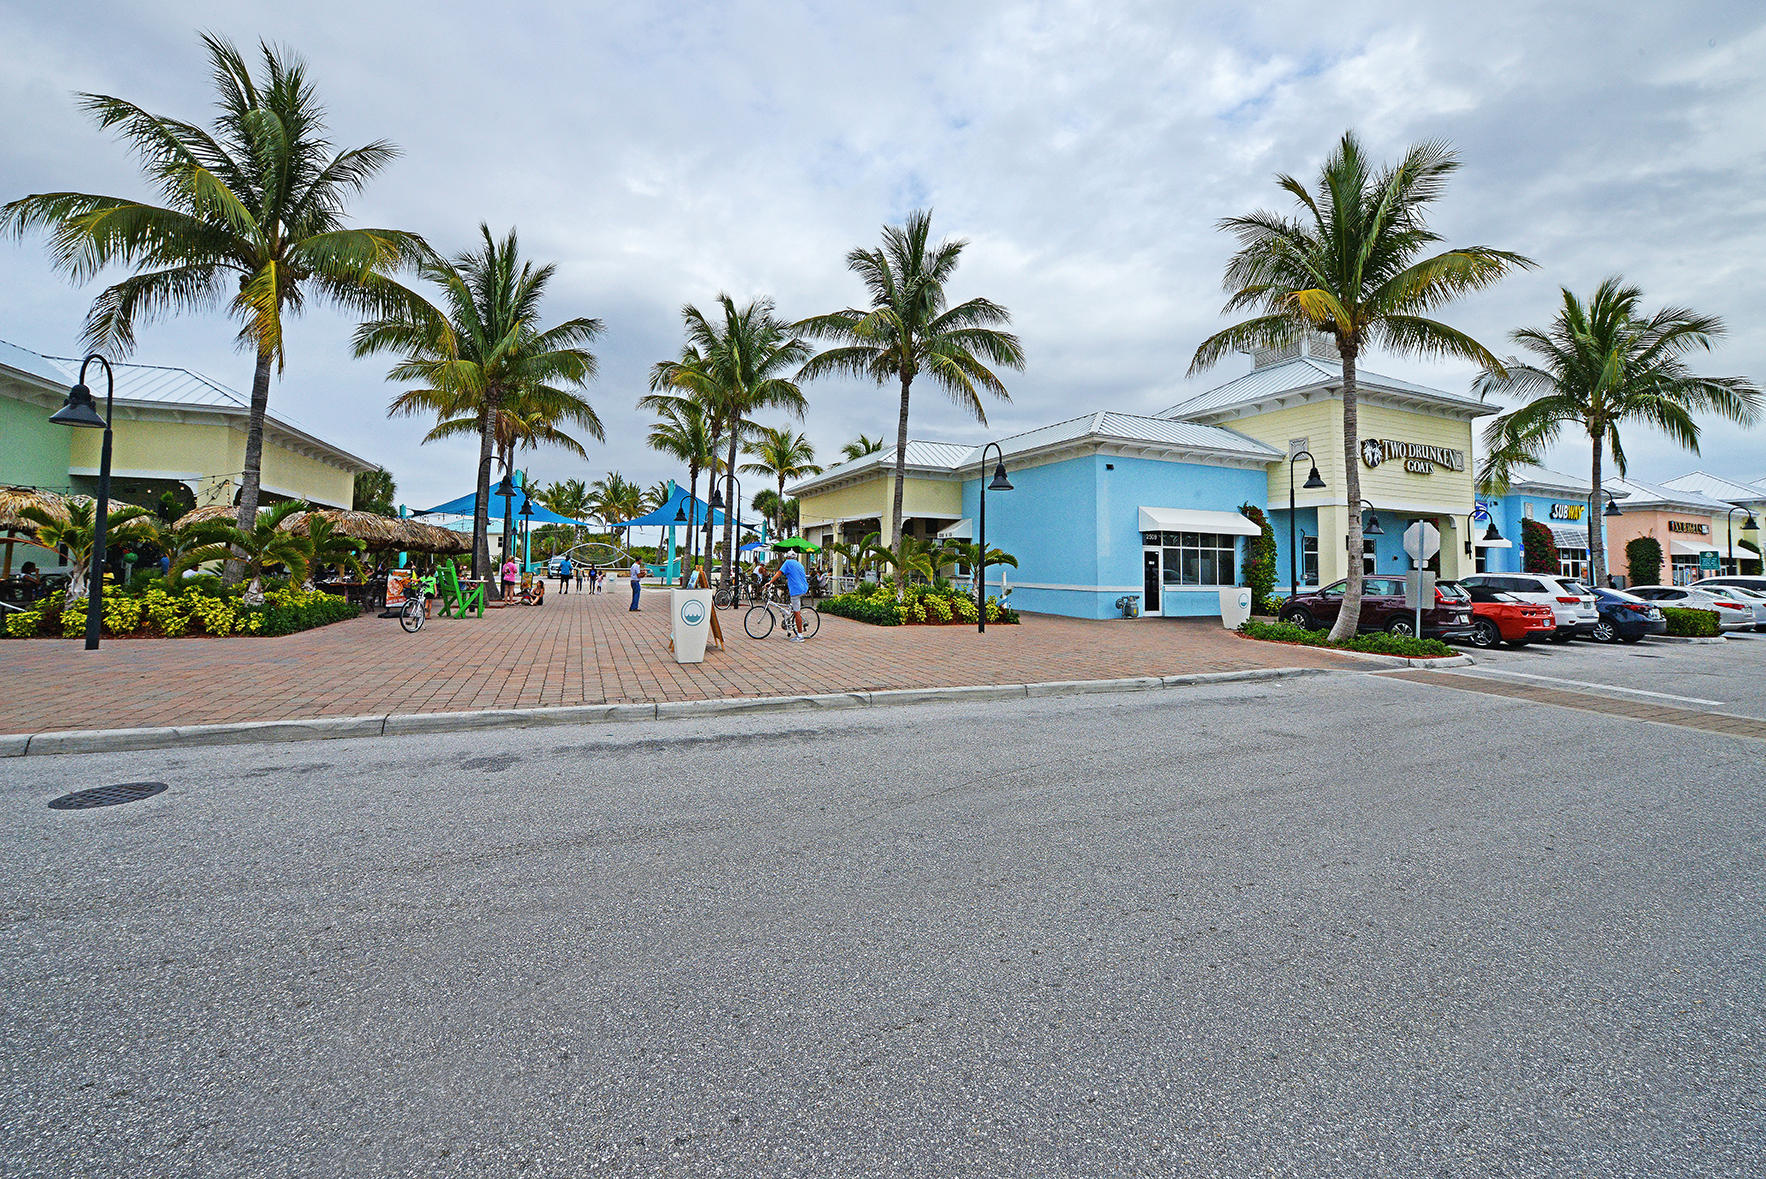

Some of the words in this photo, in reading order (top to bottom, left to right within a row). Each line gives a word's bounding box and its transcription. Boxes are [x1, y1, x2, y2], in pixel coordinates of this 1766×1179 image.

[1383, 440, 1407, 461] TWO
[1408, 443, 1456, 470] DRUNKEN
[1407, 460, 1434, 474] GOATS
[1552, 503, 1585, 520] SUBWAY
